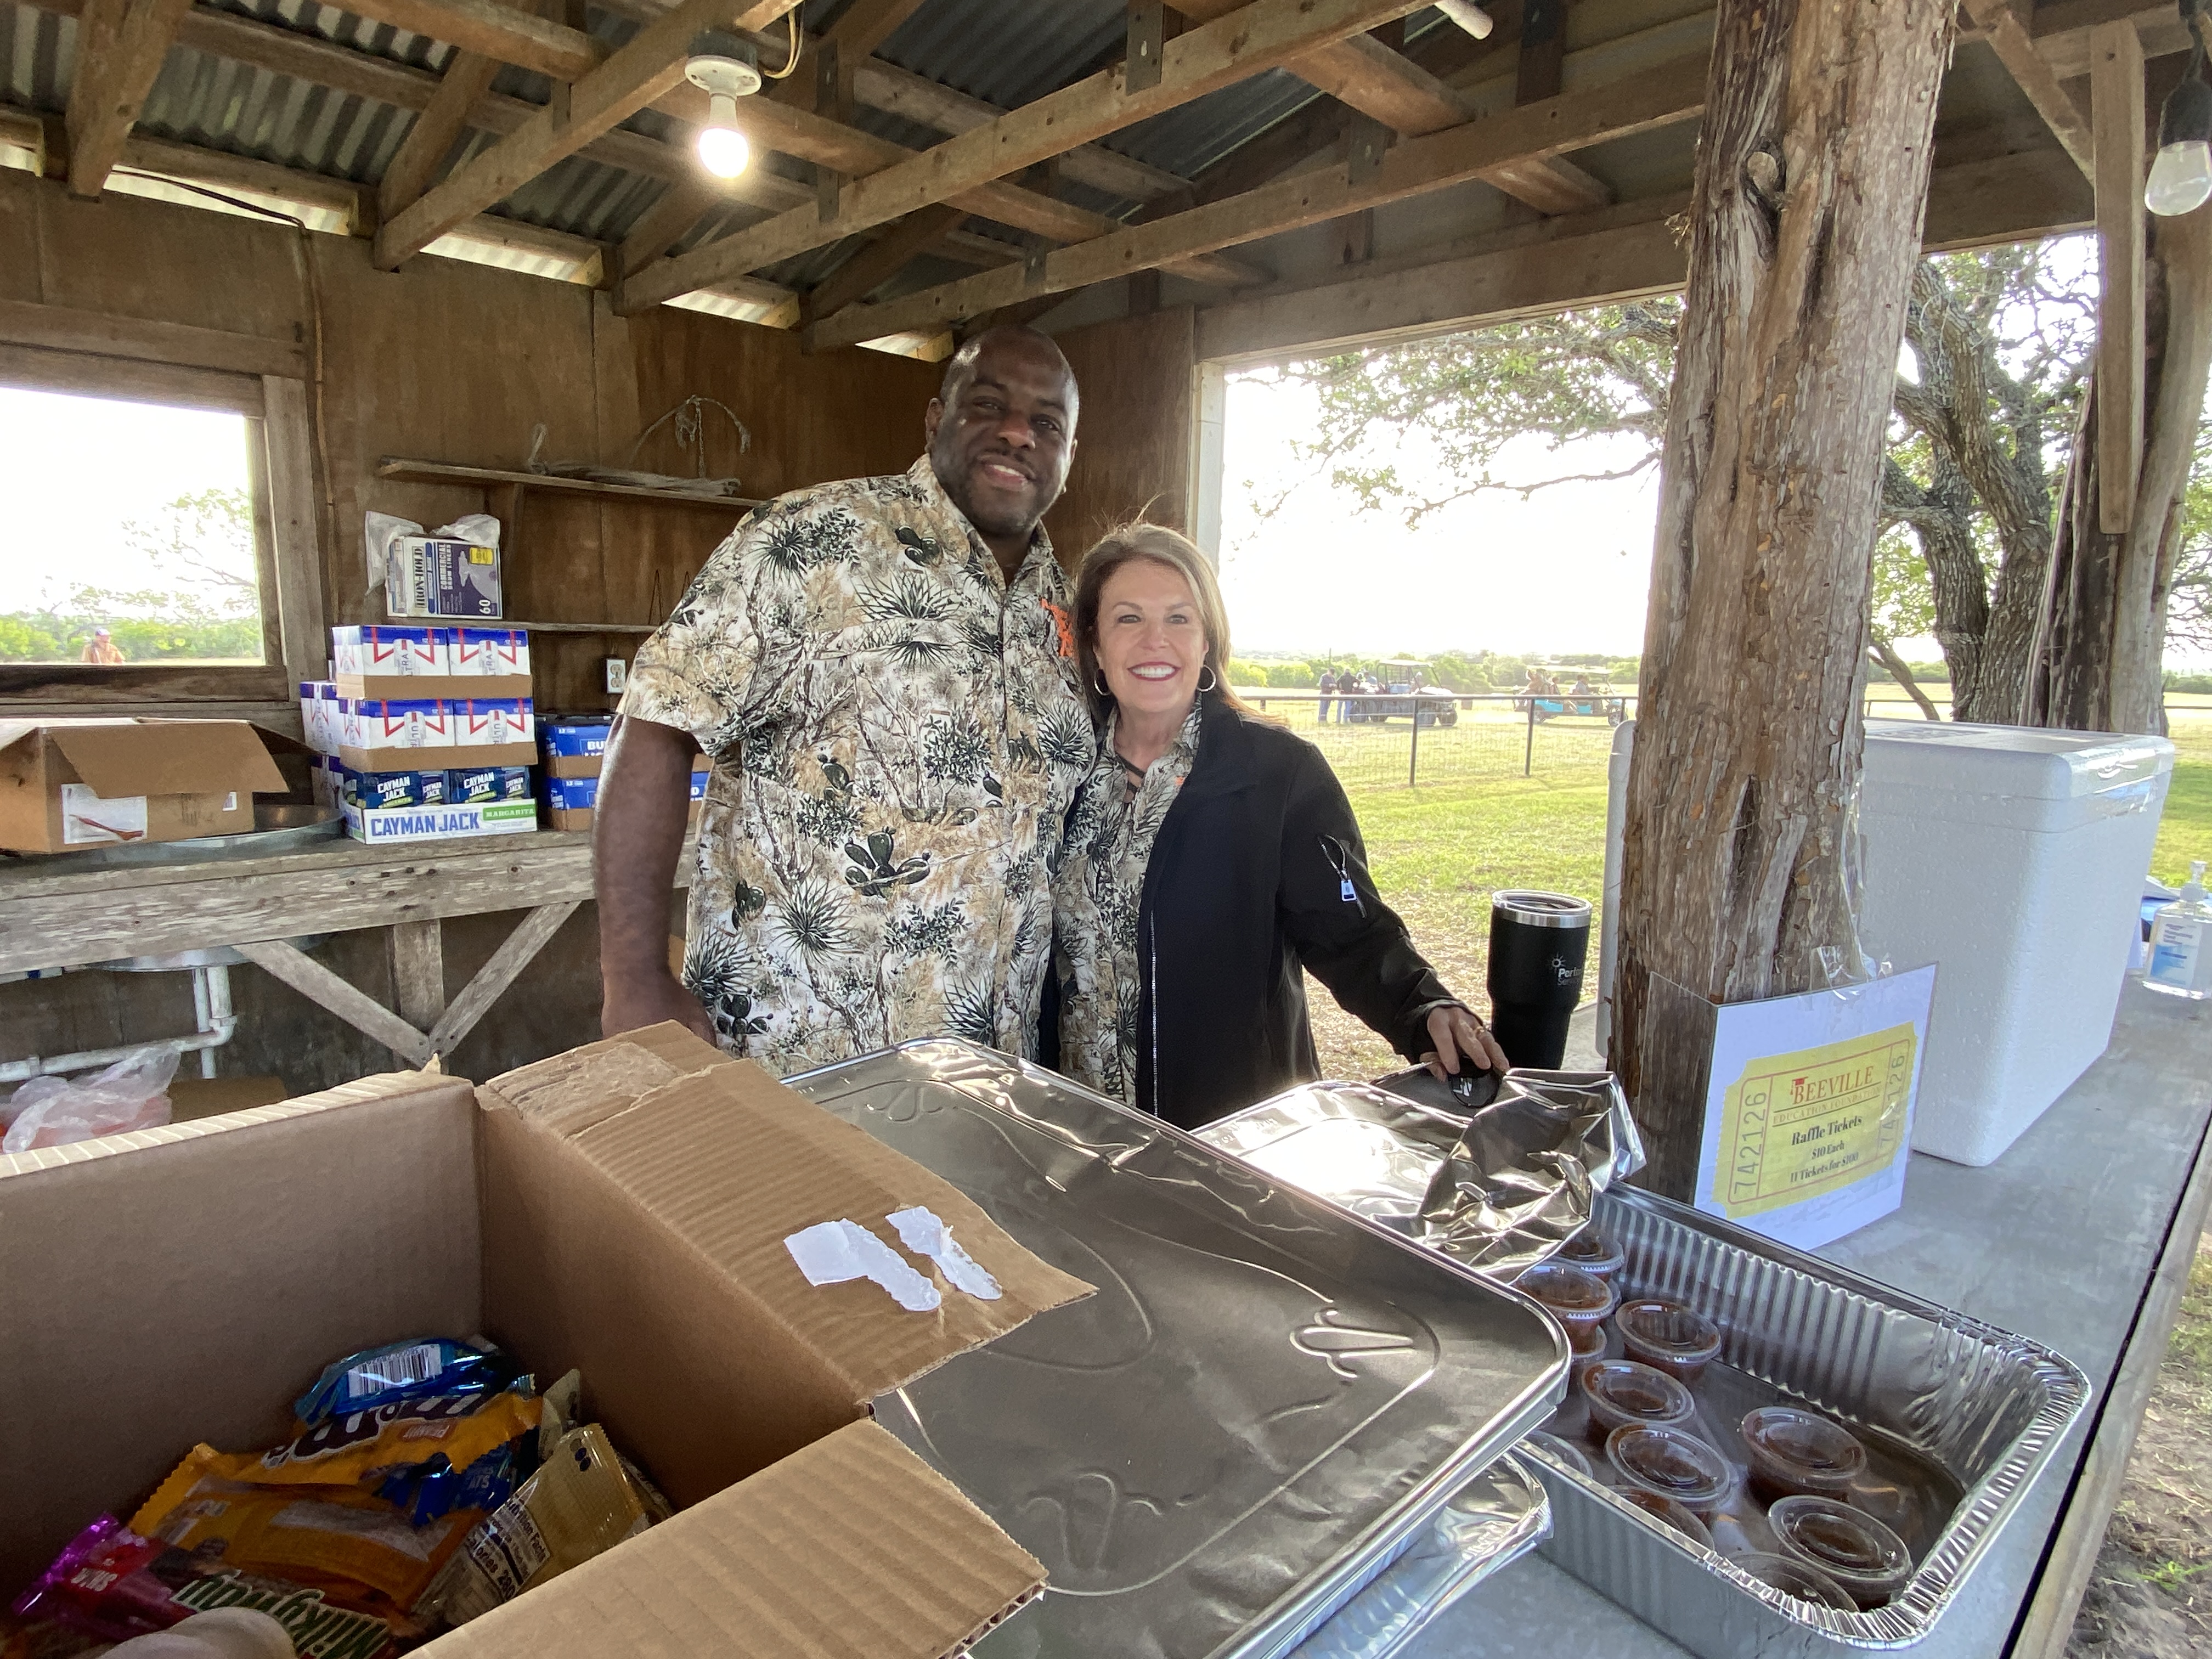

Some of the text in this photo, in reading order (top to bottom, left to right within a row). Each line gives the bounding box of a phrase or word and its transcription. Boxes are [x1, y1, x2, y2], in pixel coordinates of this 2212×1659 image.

[439, 543, 447, 590] COMMERCIAL
[414, 548, 425, 606] IRON-HOLD
[478, 599, 491, 614] 60
[587, 741, 605, 751] BU
[377, 776, 410, 794] CAYMAN
[422, 781, 442, 793] CAYMAN
[464, 772, 494, 789] CAYMAN
[505, 777, 524, 788] CAYMAN
[509, 784, 522, 794] JACK
[383, 787, 406, 802] JACK
[426, 788, 440, 798] JACK
[469, 782, 490, 797] JACK
[486, 809, 534, 818] MARGARITA
[371, 815, 436, 836] CAYMAN
[439, 812, 479, 832] JACK
[1792, 1065, 1874, 1105] BEEVILLE
[1773, 1086, 1882, 1124] EDUCATION FOUNDATION
[1791, 1115, 1863, 1146] Raffle Tickets
[1734, 1092, 1767, 1194] 742126
[1812, 1140, 1844, 1160] $10 Each
[1791, 1152, 1859, 1183] 11 Tickets for $100
